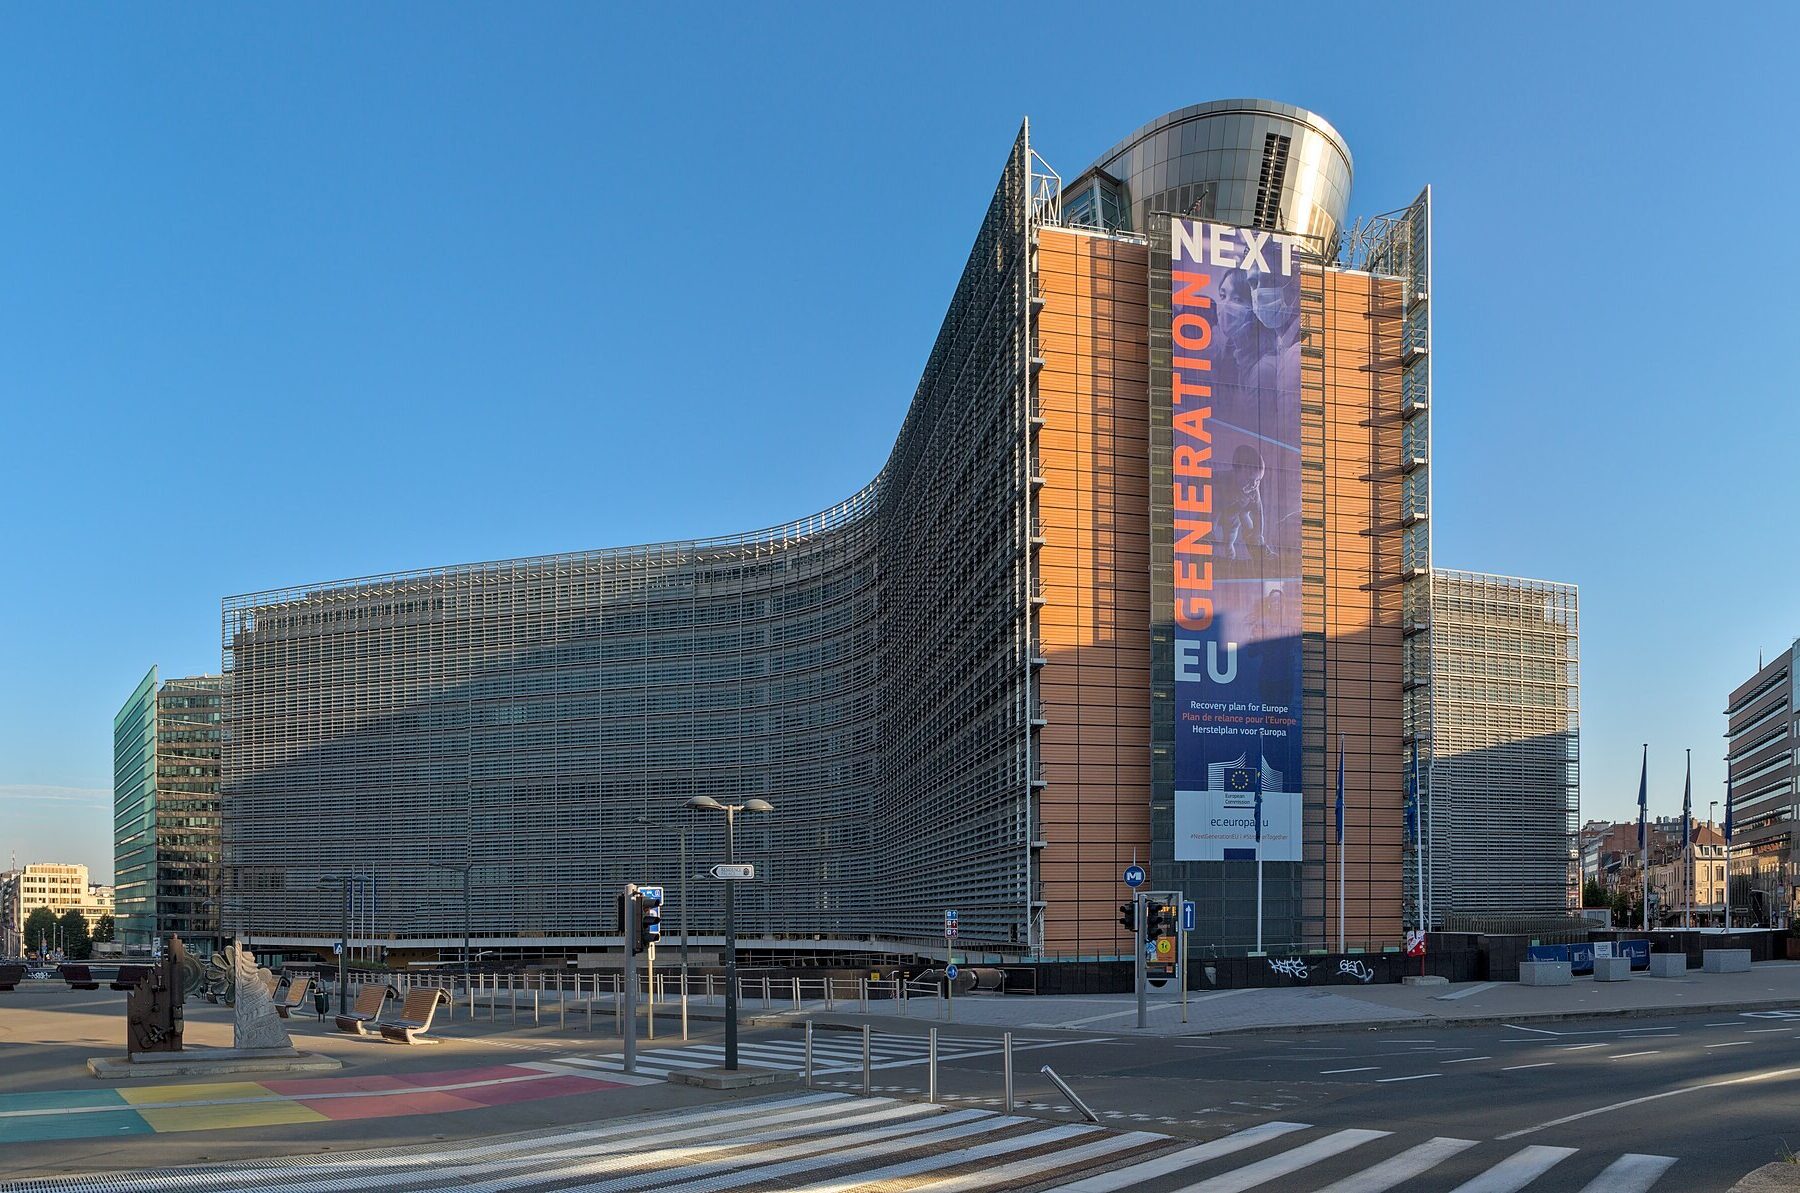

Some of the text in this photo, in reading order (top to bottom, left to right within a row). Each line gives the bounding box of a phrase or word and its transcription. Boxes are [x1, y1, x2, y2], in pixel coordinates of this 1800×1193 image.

[1172, 217, 1299, 277] NEXT
[1172, 270, 1213, 631] GENERATION
[1175, 639, 1238, 684] EU
[1190, 700, 1289, 714] Recovery plan for Europe
[1182, 712, 1297, 726] Plan de relance pour l'Europe
[1192, 724, 1238, 736] Herstelplan
[1260, 728, 1287, 738] Europa
[1210, 818, 1269, 828] ec.europau
[1126, 871, 1142, 881] M
